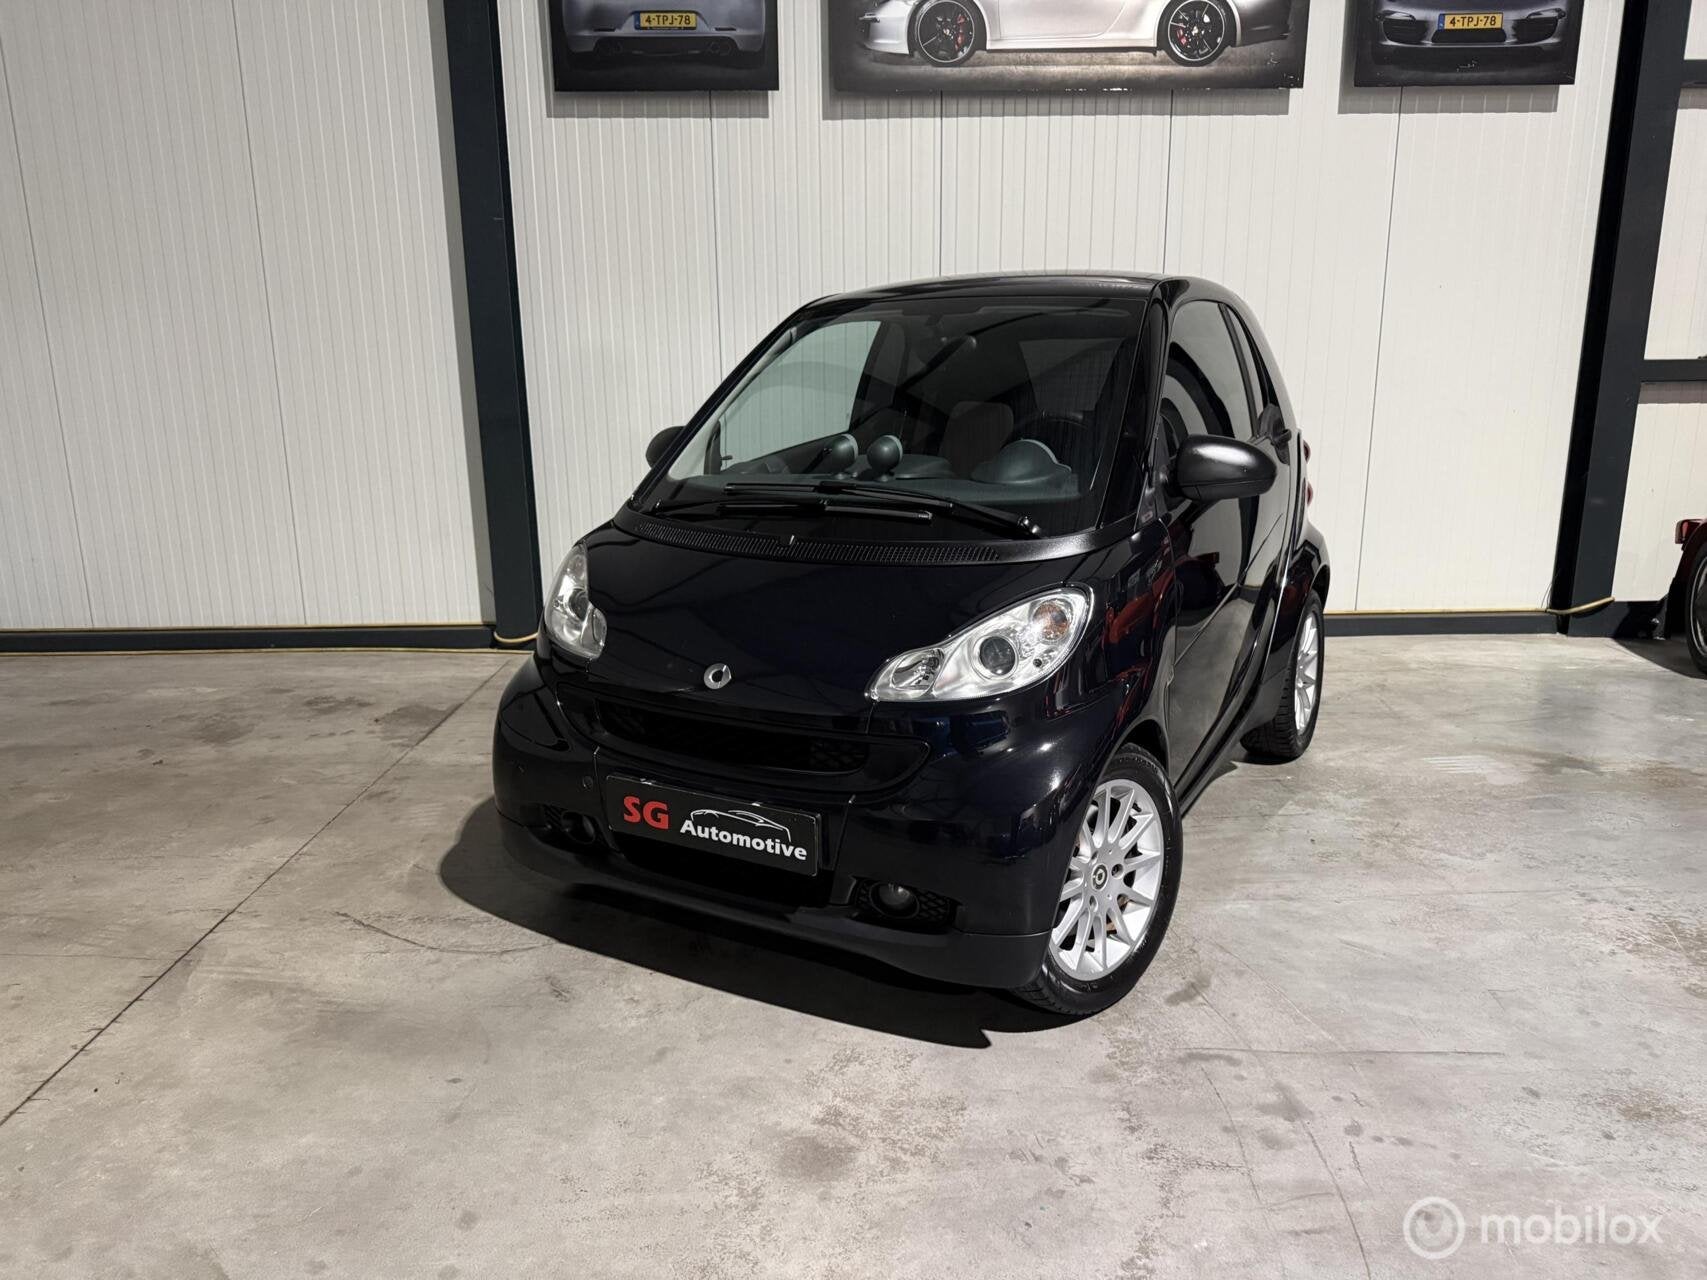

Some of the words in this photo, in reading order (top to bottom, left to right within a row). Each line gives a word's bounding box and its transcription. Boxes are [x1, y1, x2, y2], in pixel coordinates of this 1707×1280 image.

[645, 14, 691, 25] 4-TPJ-78
[1449, 15, 1497, 27] 4-TPJ-78
[623, 796, 669, 830] SG
[680, 819, 808, 860] Automotive
